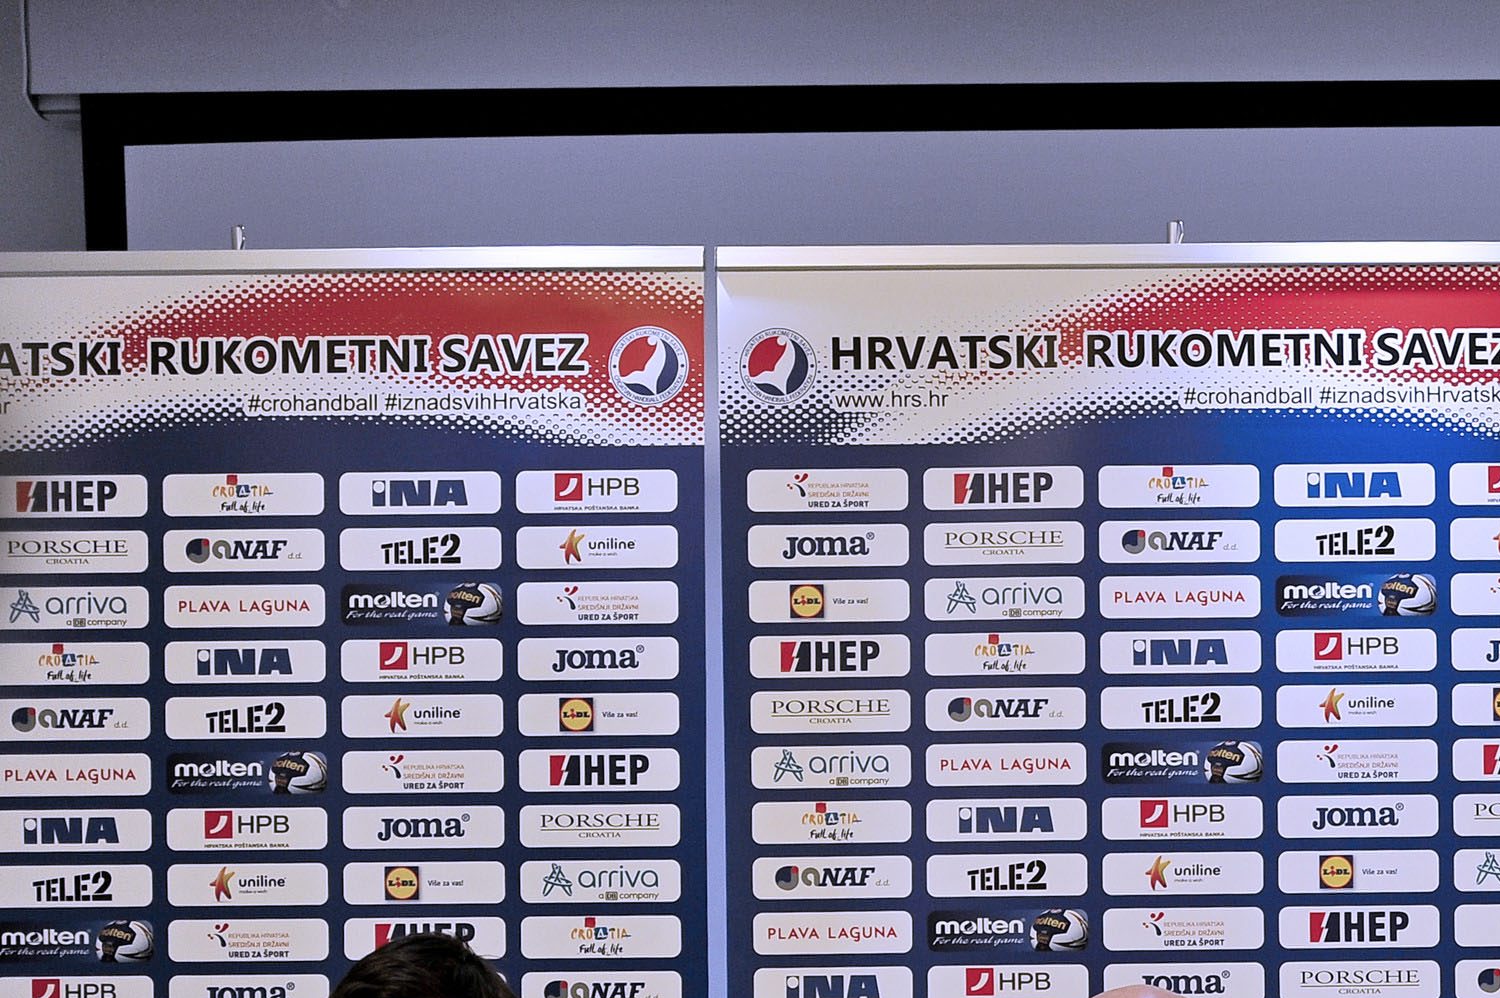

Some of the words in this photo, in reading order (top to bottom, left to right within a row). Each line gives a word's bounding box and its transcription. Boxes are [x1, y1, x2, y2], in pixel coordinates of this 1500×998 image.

[150, 339, 428, 375] RUKOMETNI
[441, 336, 585, 373] SAVEZ
[832, 335, 1057, 371] HRVATSKI
[1087, 331, 1362, 370] RUKOMETNI
[248, 393, 378, 412] #crohandball
[385, 391, 581, 411] #iznadsvihHrvatska
[836, 392, 948, 408] www.hrs.hr
[1184, 386, 1313, 405] #crohandball
[212, 484, 272, 498] CROATIA
[587, 476, 639, 495] HPB
[989, 473, 1052, 503] HEP
[53, 481, 116, 511] HEP
[8, 540, 126, 554] PORSCHE
[587, 537, 633, 550] uniline
[1316, 524, 1395, 555] TELE2
[982, 582, 1062, 605] arriva
[1283, 580, 1371, 600] molten
[772, 699, 890, 714] PORSCHE
[206, 702, 285, 732] TELE2
[174, 757, 262, 778] molten
[940, 758, 993, 771] PLAVA
[1002, 757, 1070, 774] LAGUNA
[4, 768, 57, 782] PLAVA
[66, 768, 134, 784] LAGUNA
[438, 780, 465, 789] ŠPORT
[578, 865, 658, 888] arriva
[619, 892, 658, 900] company
[1345, 912, 1408, 942] HEP
